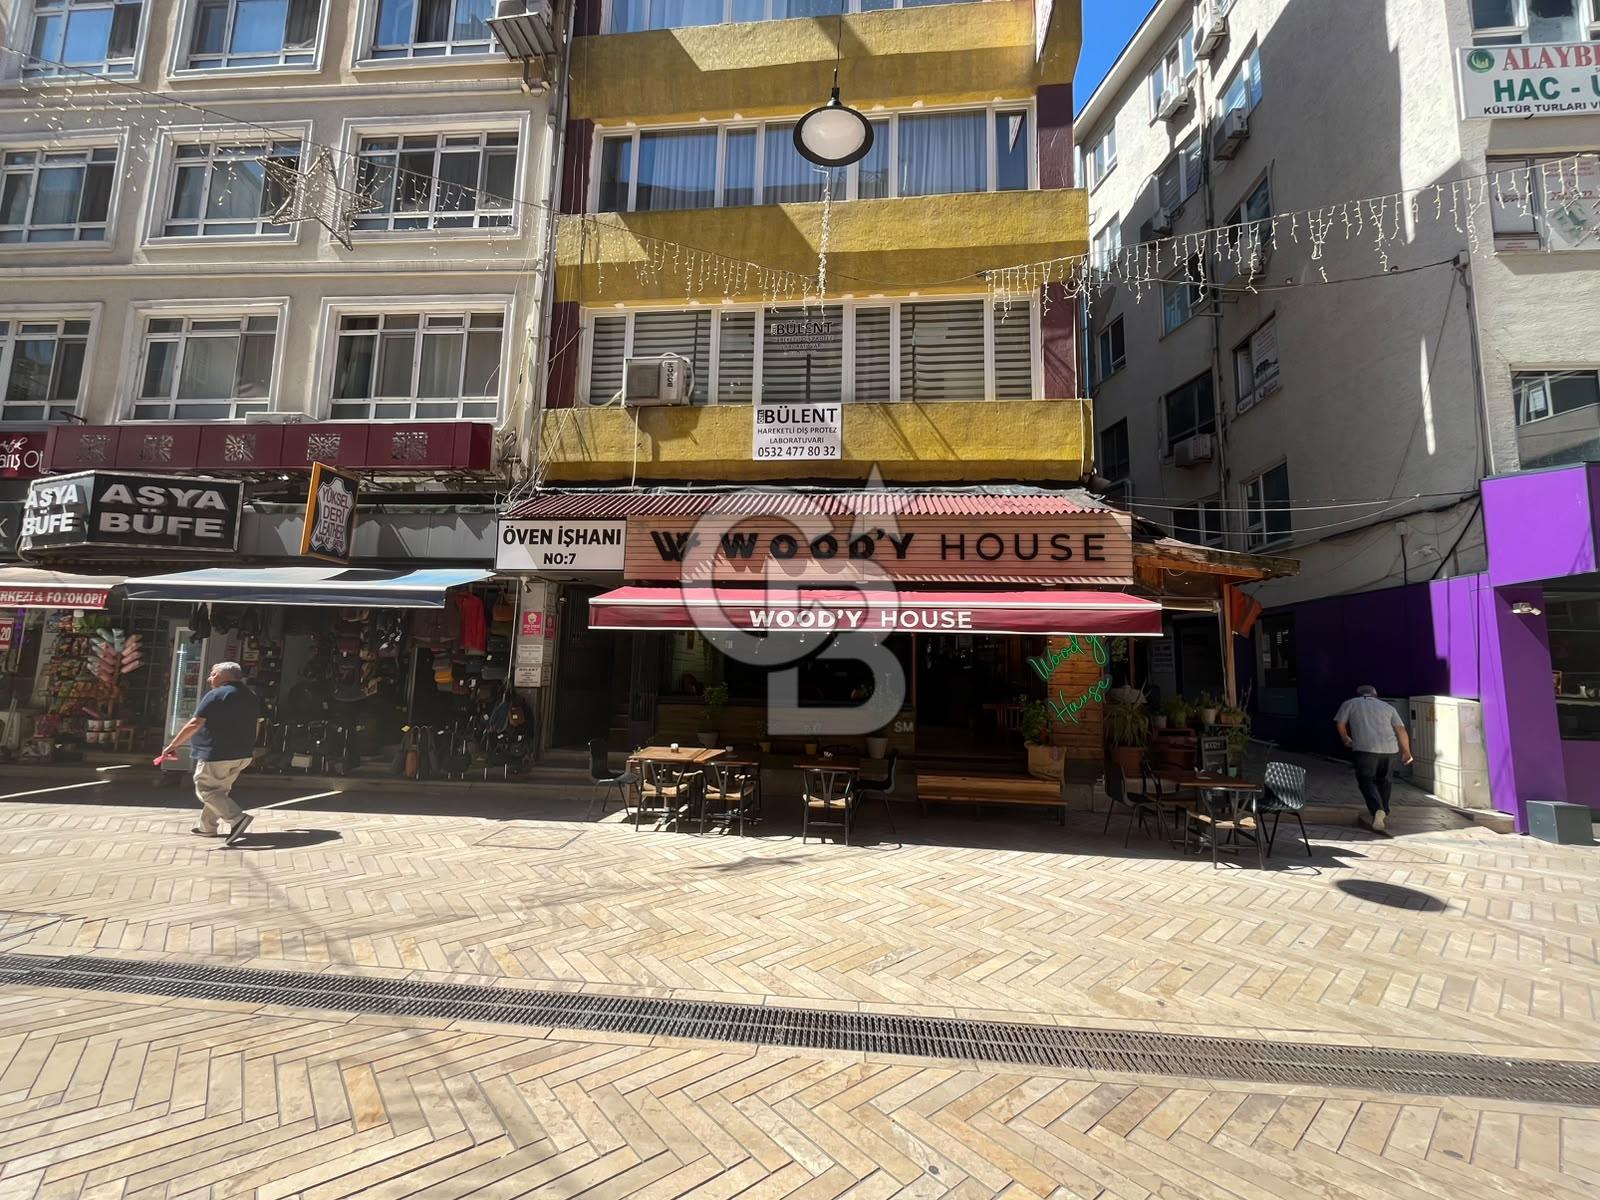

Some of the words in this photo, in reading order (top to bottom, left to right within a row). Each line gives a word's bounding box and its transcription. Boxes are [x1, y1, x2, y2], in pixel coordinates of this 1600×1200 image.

[1493, 77, 1560, 102] HAC
[1484, 103, 1531, 114] KÜLTÜR
[1535, 102, 1586, 113] TURLARI
[777, 320, 833, 335] BÜLENT
[765, 405, 838, 424] BÜLENT
[797, 426, 809, 434] DİŞ
[758, 446, 783, 457] 0532
[786, 446, 805, 456] 477
[807, 446, 821, 456] 80
[823, 446, 836, 456] 32
[24, 484, 78, 509] ASYA
[99, 484, 227, 510] ASYA
[322, 487, 349, 509] YÜKSEL
[22, 508, 75, 536] BÜFE
[99, 508, 226, 538] BÜFE
[319, 520, 345, 540] LEATHER
[503, 525, 553, 545] ÖVEN
[558, 526, 621, 547] İŞHANI
[720, 529, 914, 560] WOOD'Y
[941, 532, 1106, 561] HOUSE
[543, 552, 577, 565] NO:7
[749, 608, 863, 628] WOOD'Y
[881, 610, 973, 629] HOUSE
